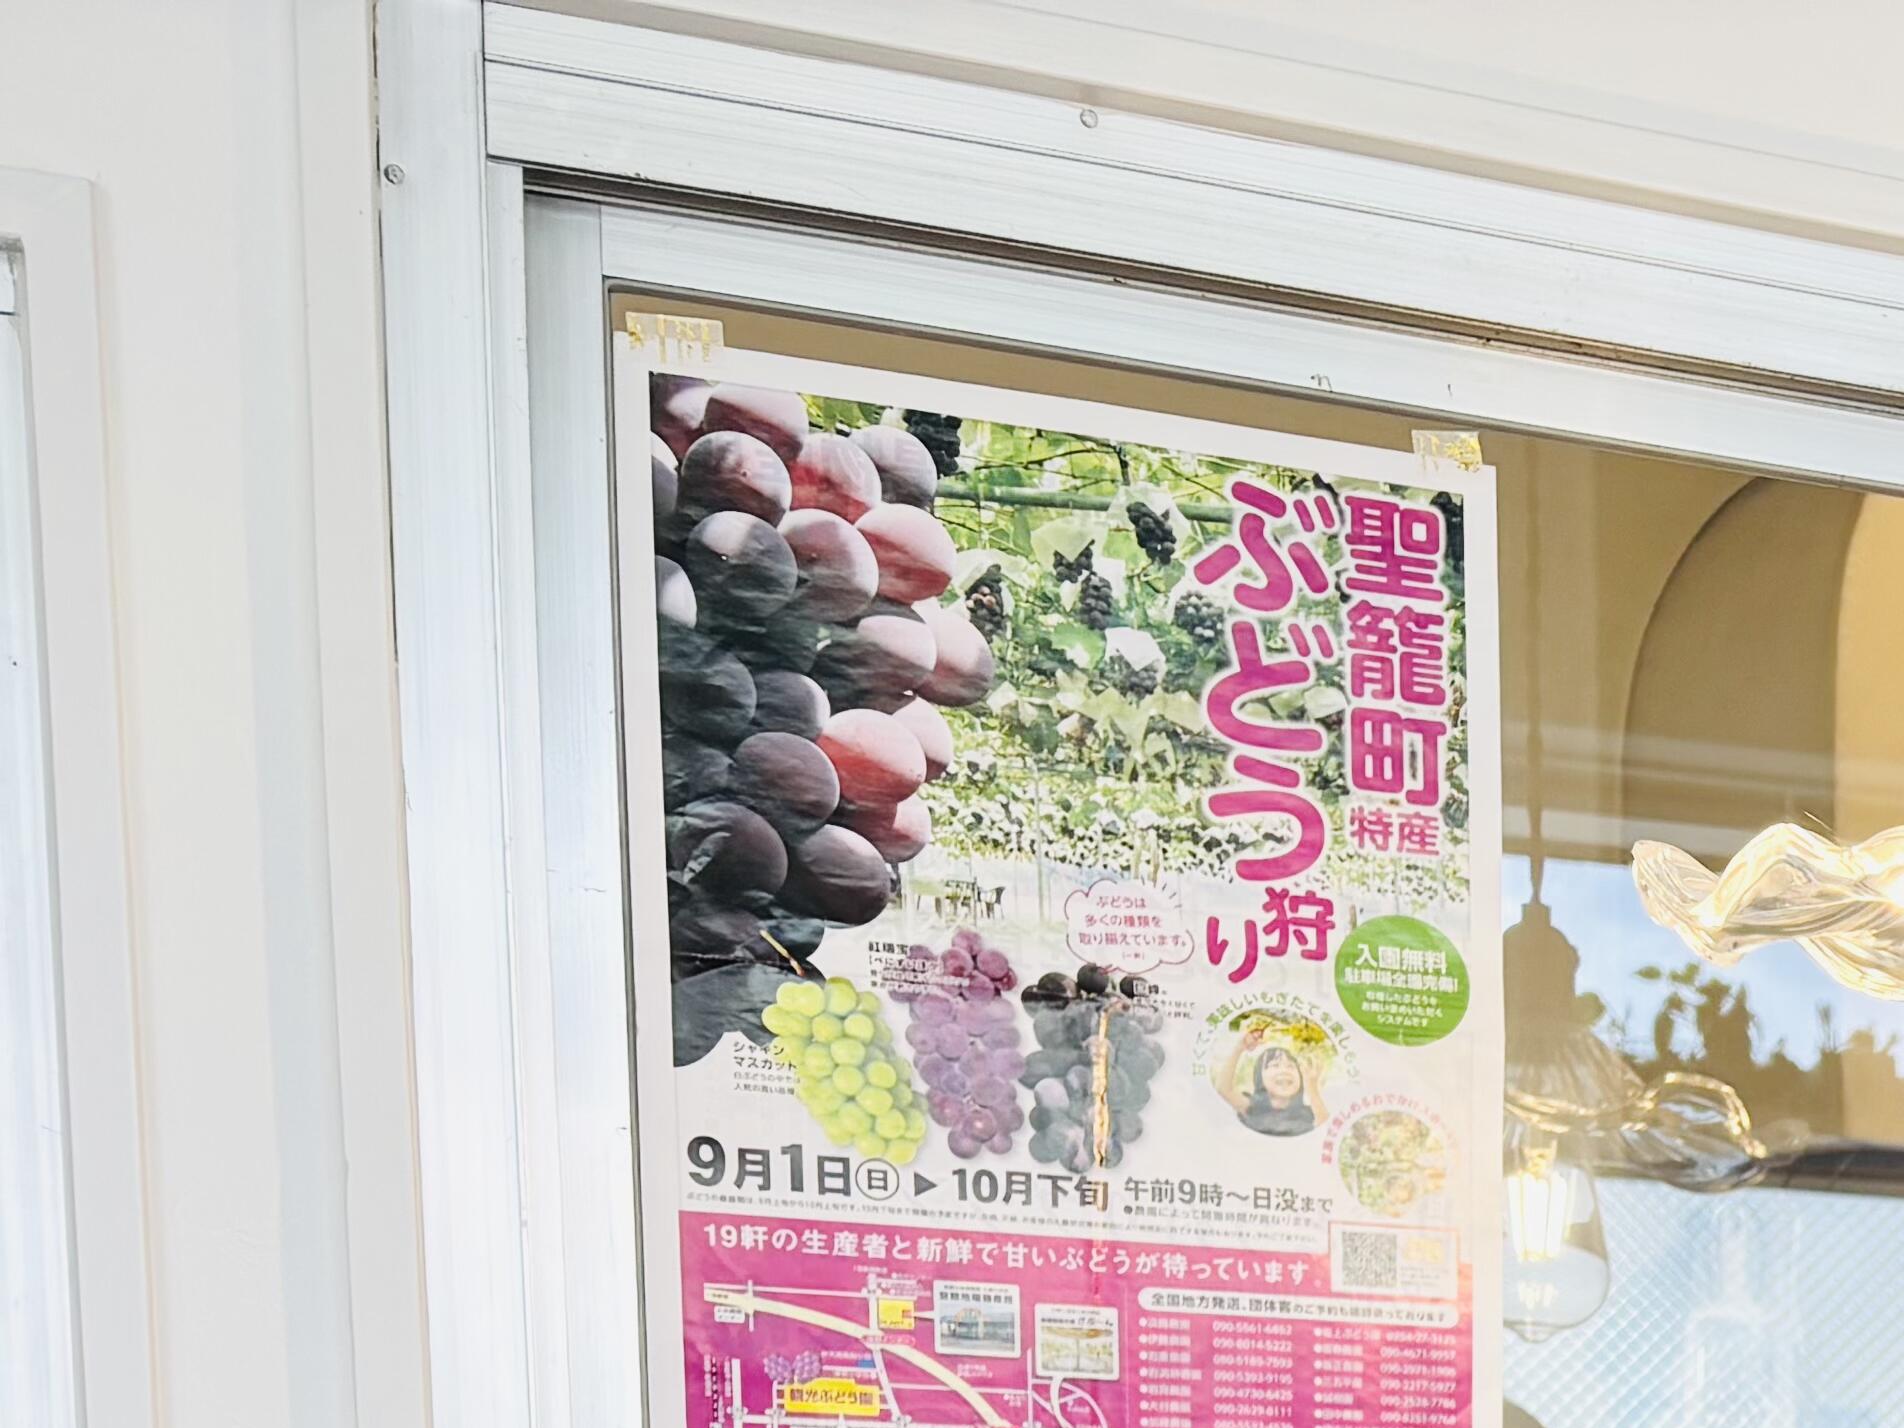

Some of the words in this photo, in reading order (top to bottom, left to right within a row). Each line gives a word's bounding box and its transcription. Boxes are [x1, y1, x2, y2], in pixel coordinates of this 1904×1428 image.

[1344, 496, 1447, 806] 聖籠町
[1350, 807, 1440, 856] 特産
[1085, 914, 1162, 929] 多くの種類を
[1355, 944, 1447, 975] 入園無料
[733, 1041, 785, 1056] シャイン
[734, 1056, 798, 1071] マスカット
